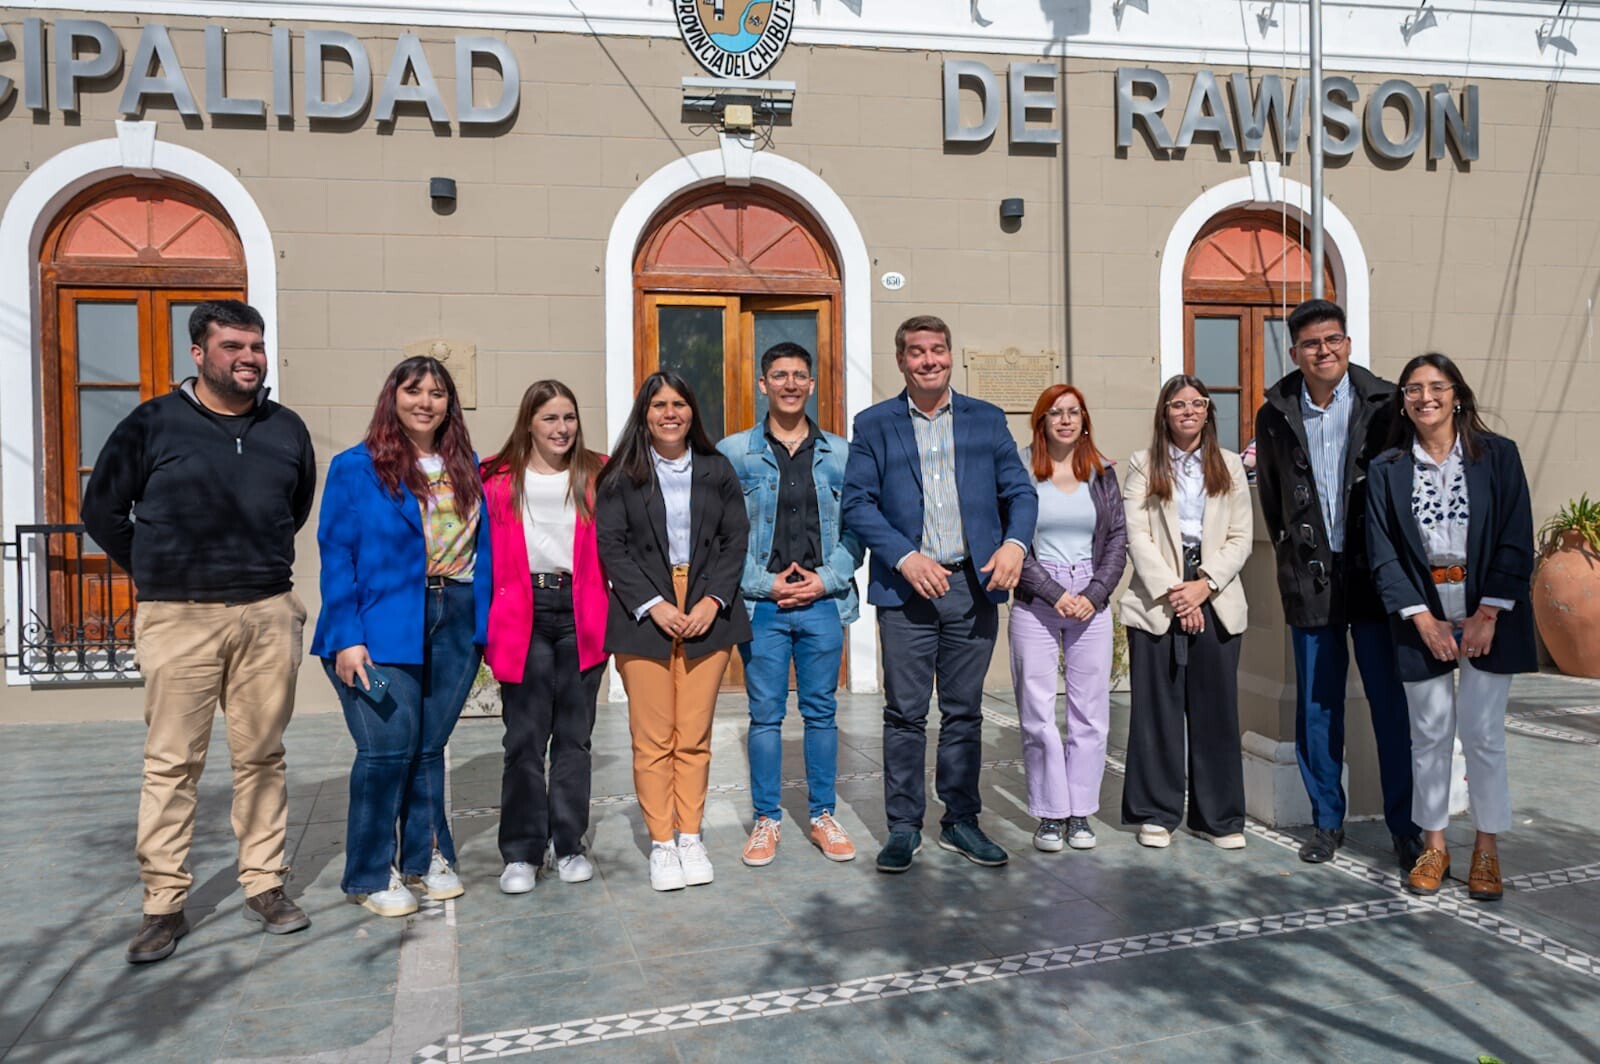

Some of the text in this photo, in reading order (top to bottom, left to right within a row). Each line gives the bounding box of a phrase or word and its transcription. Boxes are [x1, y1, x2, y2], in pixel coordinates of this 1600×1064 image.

[0, 17, 1479, 162] IPALIDAD DE RAWSON
[725, 54, 750, 77] DEL
[749, 1, 791, 72] CHUBUT
